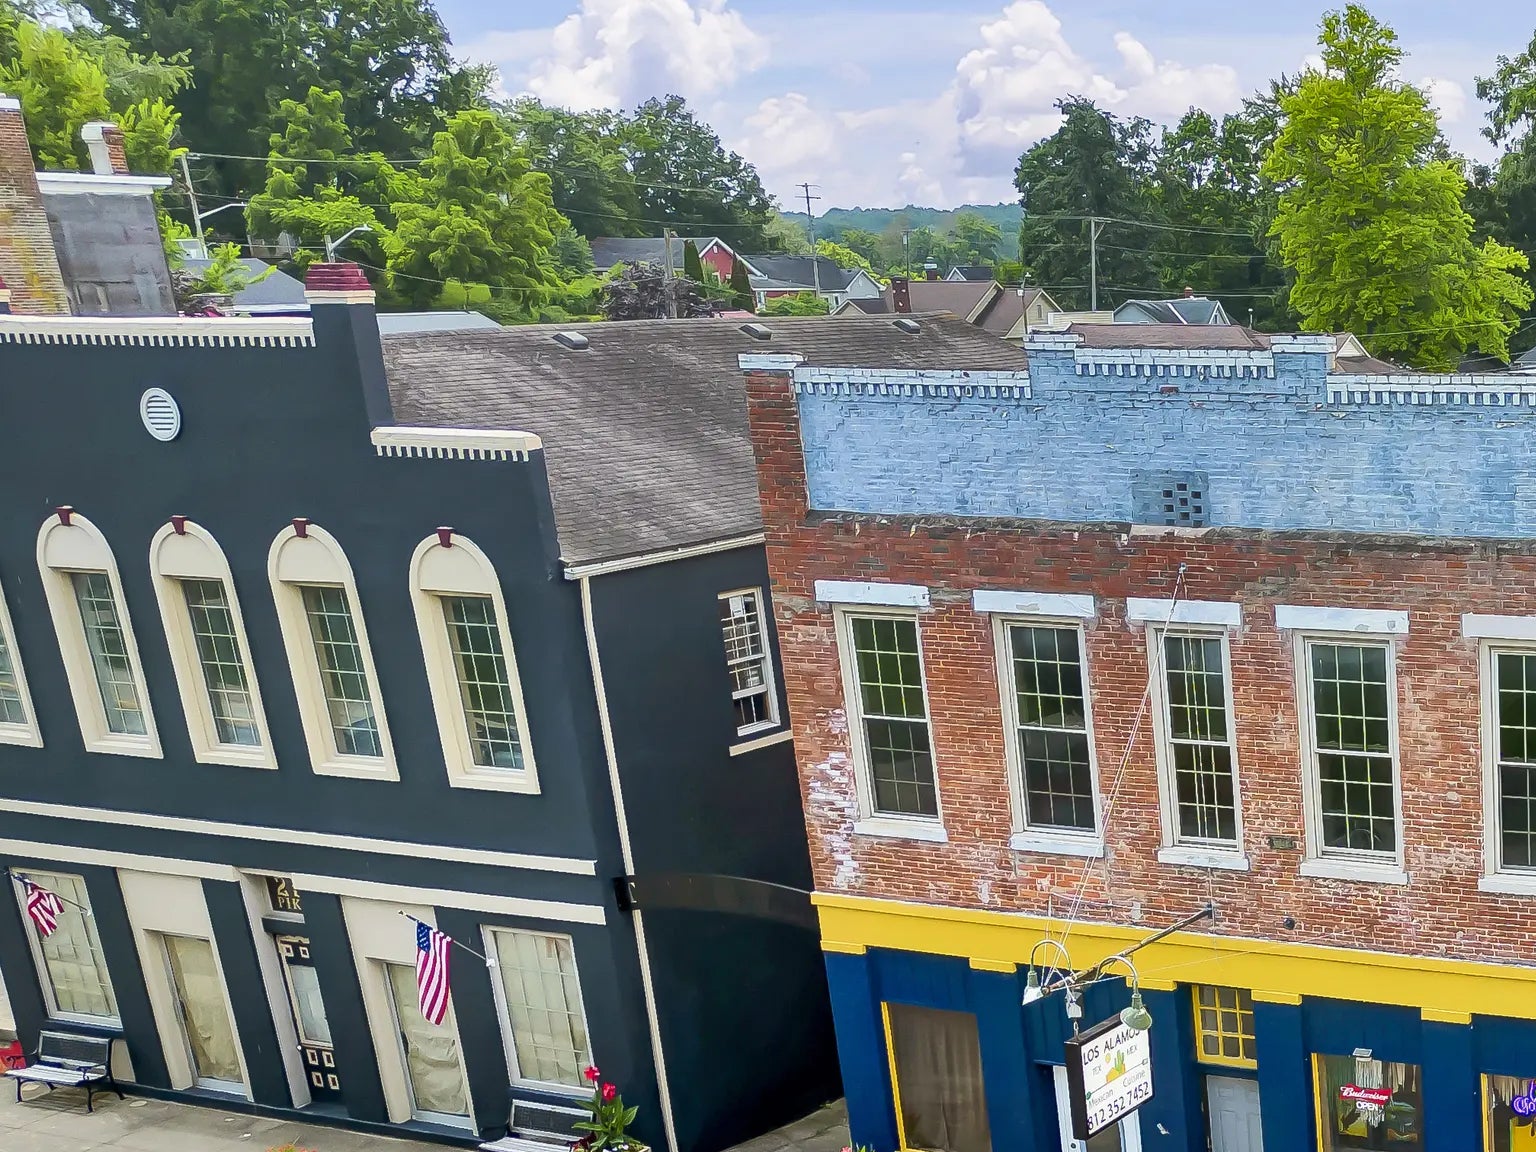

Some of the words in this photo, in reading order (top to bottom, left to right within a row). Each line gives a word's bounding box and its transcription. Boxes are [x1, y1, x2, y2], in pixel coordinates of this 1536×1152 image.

[1083, 1046, 1100, 1066] LOS
[1126, 1044, 1138, 1056] MEX
[1092, 1064, 1102, 1076] TEX
[1088, 1088, 1114, 1108] Mexican
[1340, 1086, 1389, 1101] Budweiser
[1087, 1108, 1107, 1131] 812
[1107, 1096, 1126, 1119] 352
[1126, 1081, 1149, 1106] 7452
[1356, 1100, 1378, 1111] OPEN
